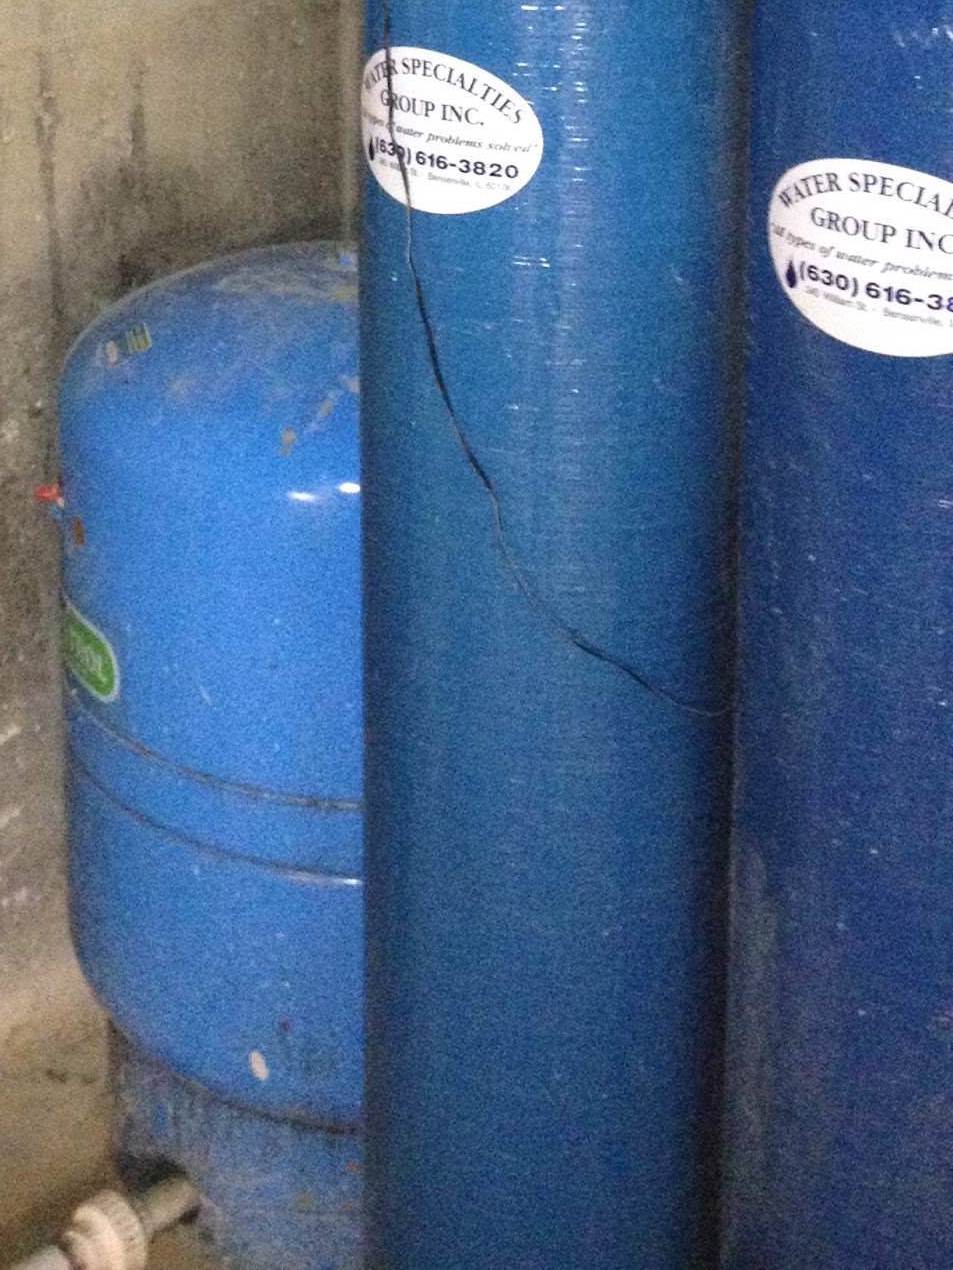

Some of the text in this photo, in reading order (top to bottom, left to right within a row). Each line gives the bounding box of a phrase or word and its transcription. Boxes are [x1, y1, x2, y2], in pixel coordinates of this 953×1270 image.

[401, 56, 526, 124] SPECIALTIES
[441, 103, 484, 127] INC.
[427, 132, 483, 149] problems
[415, 150, 519, 179] 616-3820
[778, 172, 842, 208] WATER
[810, 206, 897, 244] GROUP
[799, 260, 859, 297] (630)
